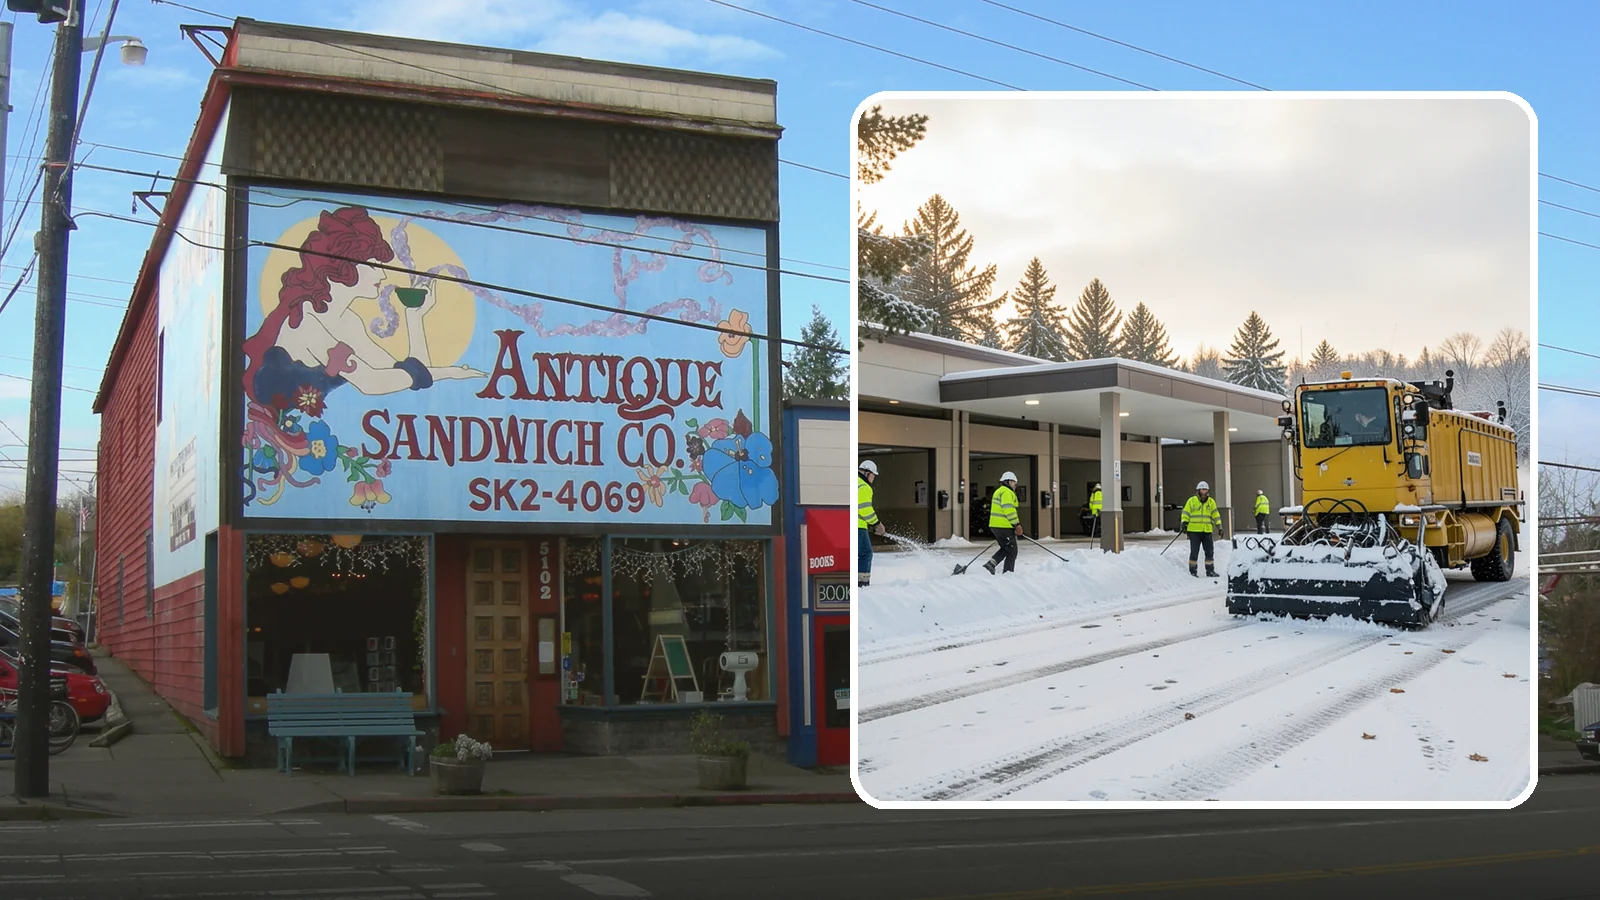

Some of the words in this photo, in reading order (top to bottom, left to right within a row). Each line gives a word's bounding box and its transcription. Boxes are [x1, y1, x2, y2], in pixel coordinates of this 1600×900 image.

[476, 328, 723, 421] ANTIQUE
[360, 408, 605, 467] SANDWICH
[617, 422, 685, 468] CO.
[468, 477, 645, 513] SK2-4069
[540, 542, 551, 599] 5102
[809, 555, 834, 568] BOOKS
